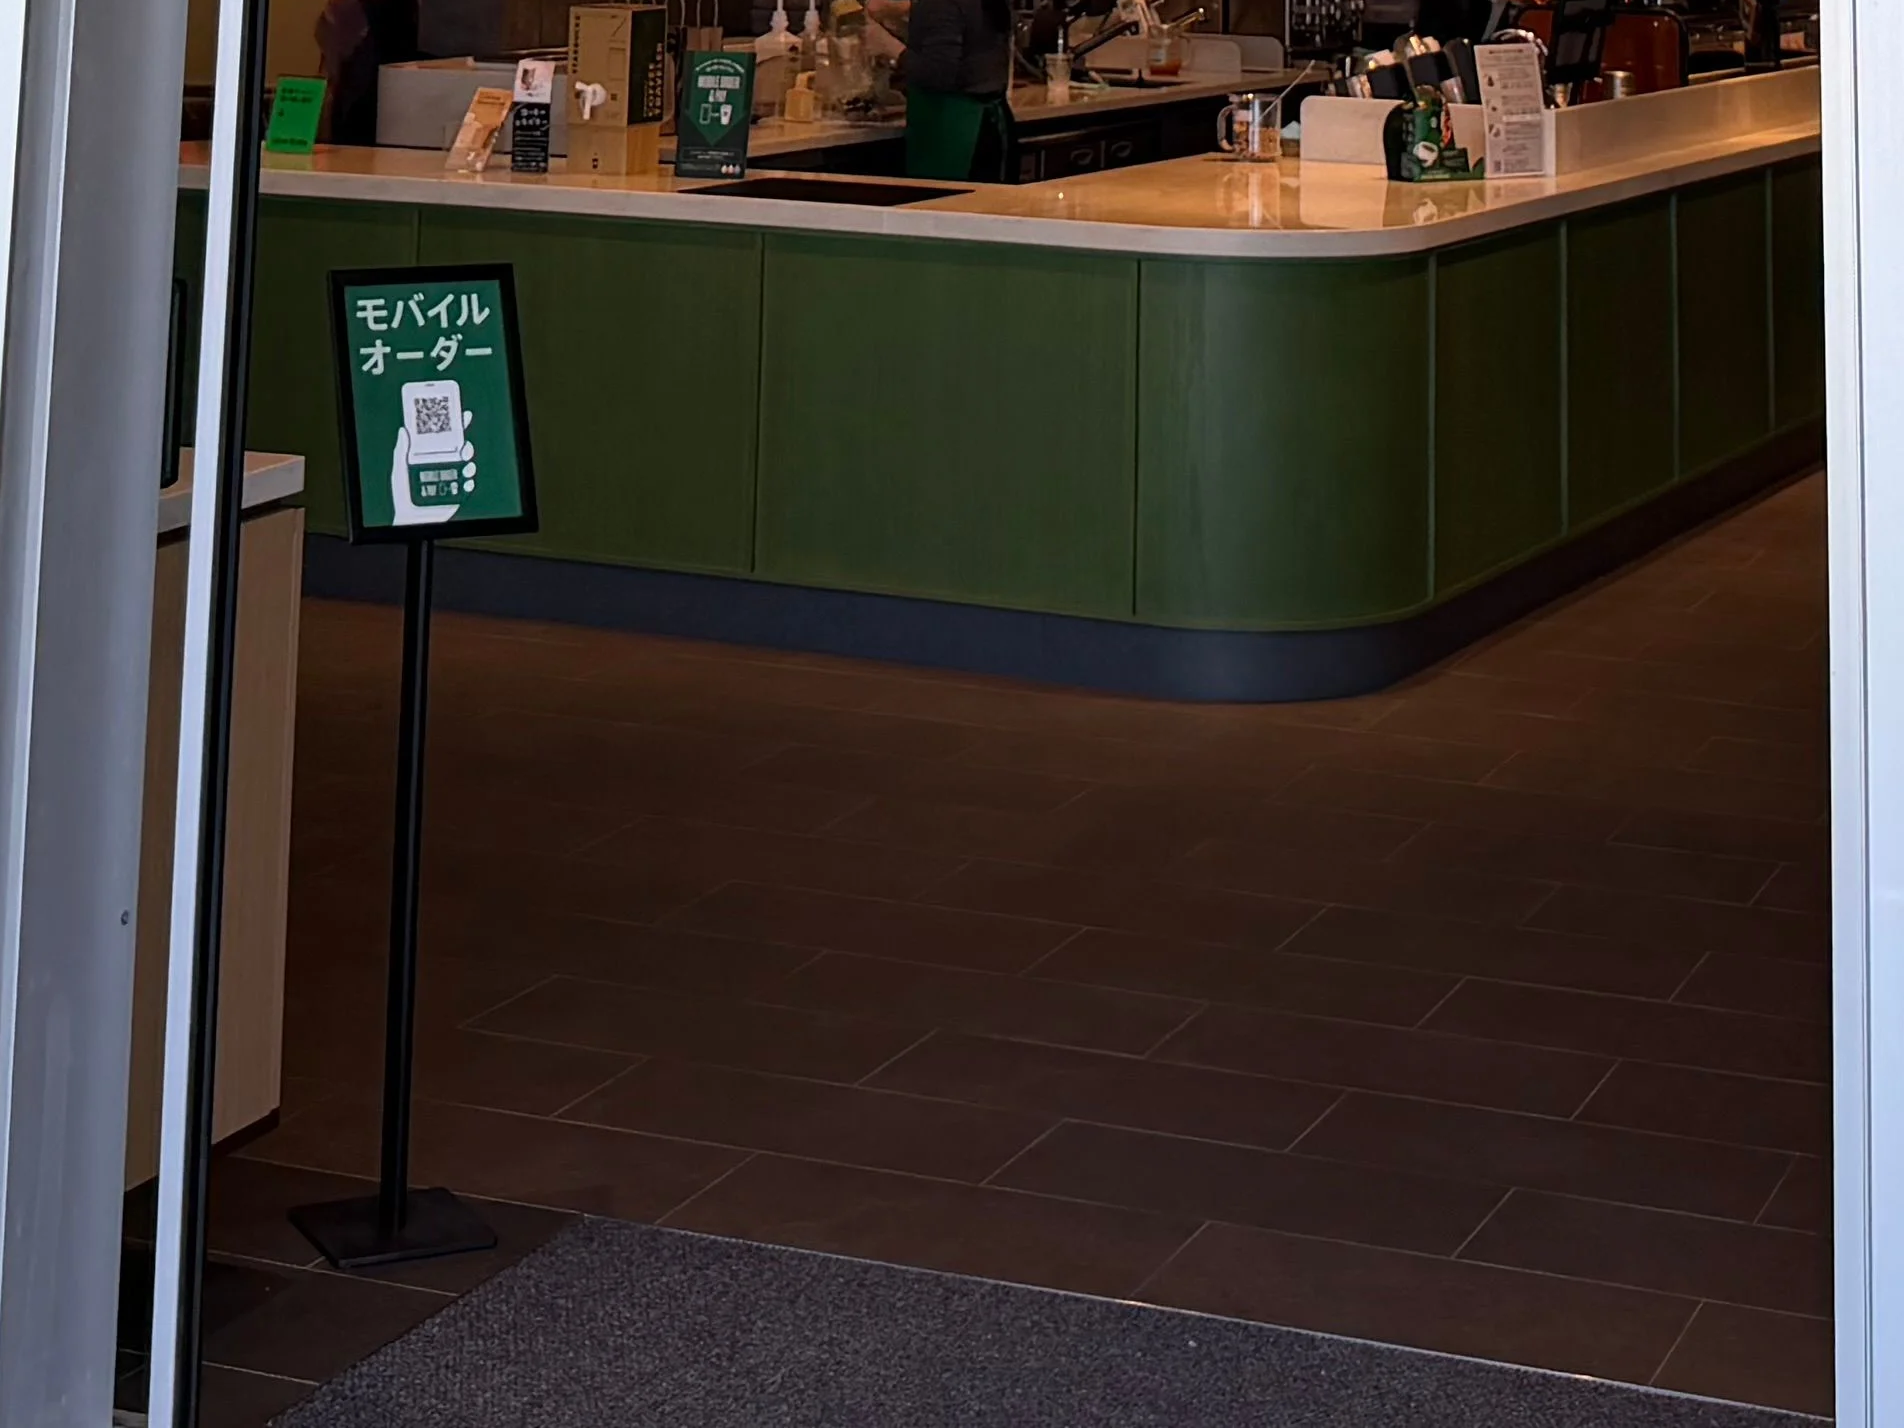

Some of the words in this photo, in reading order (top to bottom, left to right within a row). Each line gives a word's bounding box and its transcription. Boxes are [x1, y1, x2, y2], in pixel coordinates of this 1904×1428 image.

[356, 293, 490, 331] モバイル
[359, 333, 493, 375] オーダー
